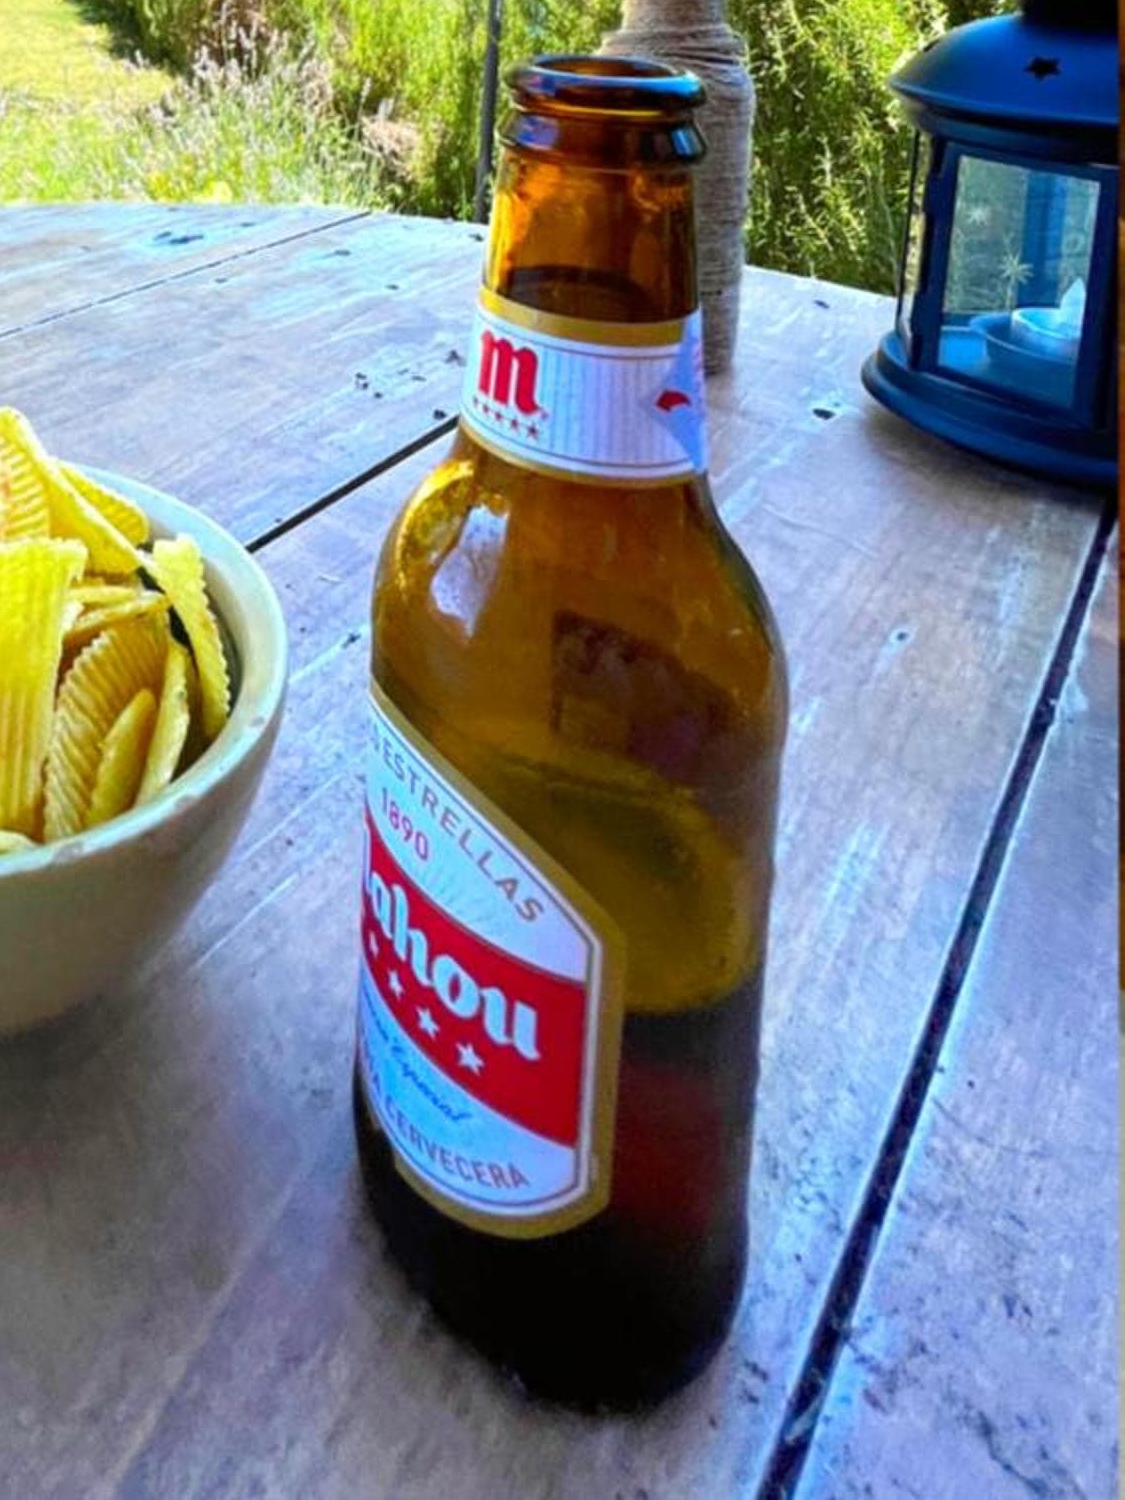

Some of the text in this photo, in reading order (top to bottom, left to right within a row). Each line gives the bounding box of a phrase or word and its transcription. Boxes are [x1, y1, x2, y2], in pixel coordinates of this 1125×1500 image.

[381, 786, 429, 861] 1890
[382, 737, 544, 922] ESTRELLAS
[364, 830, 542, 1061] ahou
[385, 1095, 531, 1189] CERVECERA
